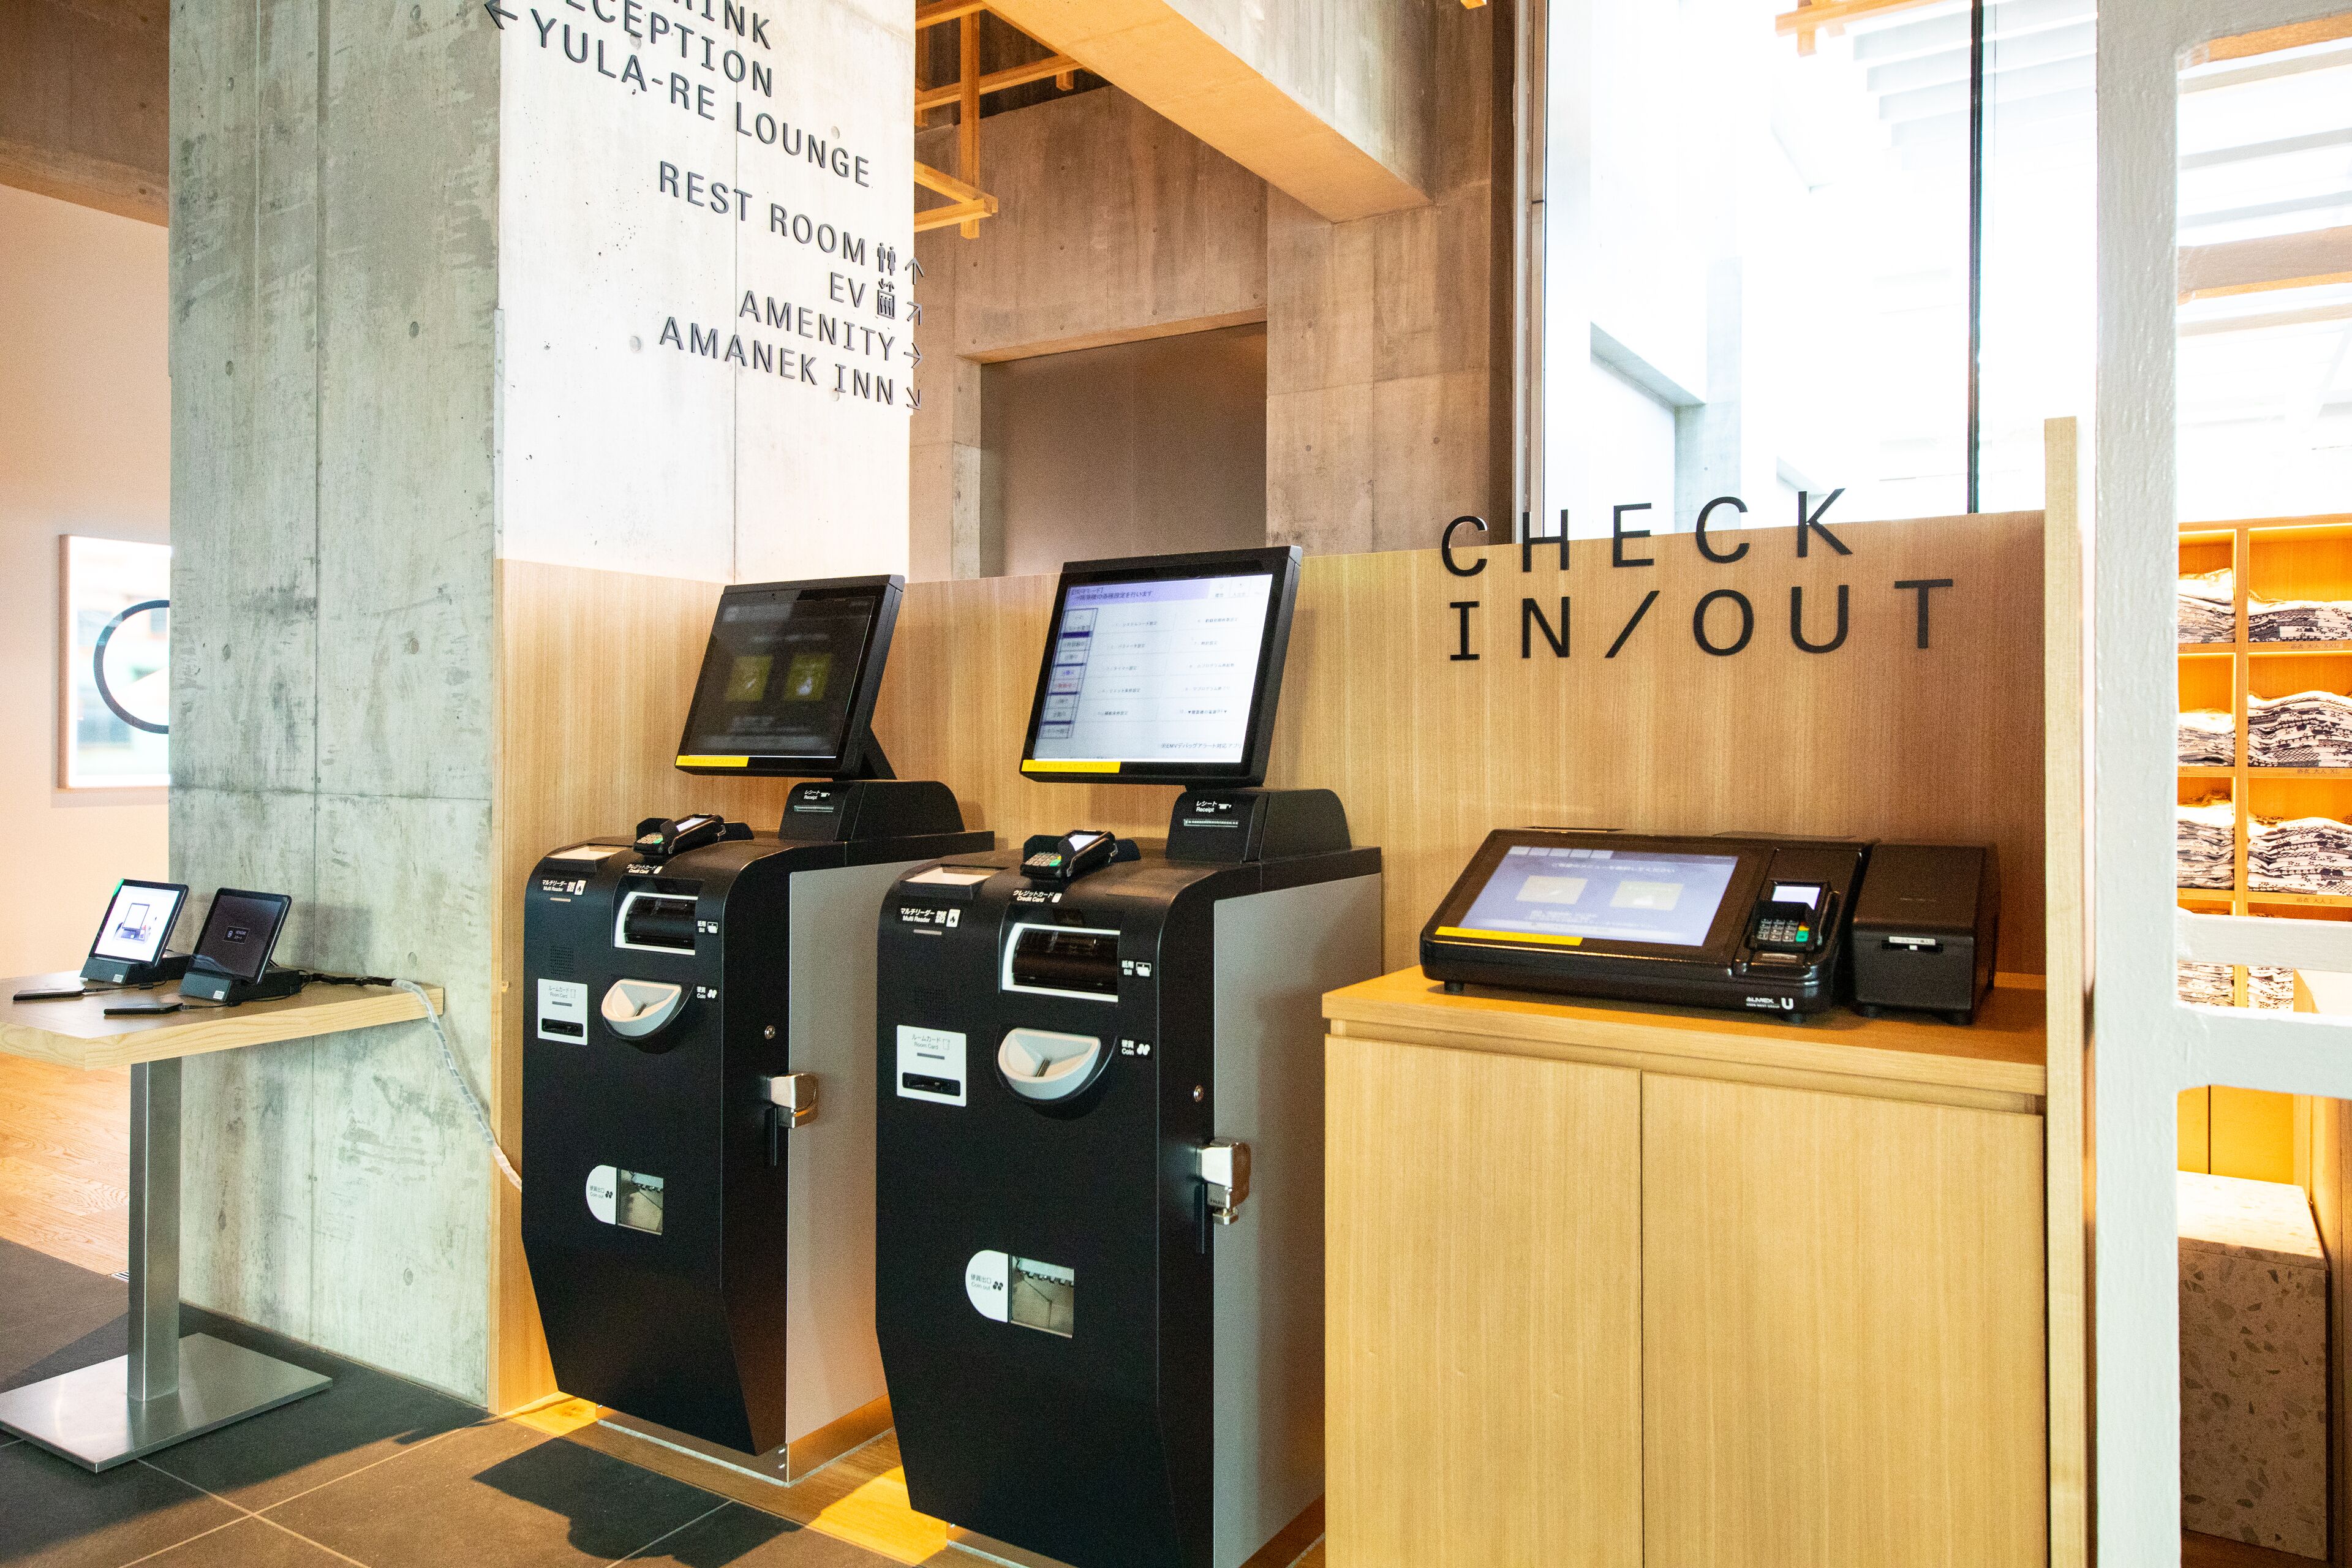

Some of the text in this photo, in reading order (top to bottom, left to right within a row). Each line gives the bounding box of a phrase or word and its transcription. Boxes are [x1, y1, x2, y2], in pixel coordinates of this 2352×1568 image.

[686, 0, 771, 50] INK
[531, 9, 869, 187] YULA-RE LOUNGE
[660, 160, 865, 266] REST ROOM
[739, 290, 895, 361] AMENITY
[831, 272, 866, 308] EV
[660, 317, 894, 405] AMANEK INN
[1441, 488, 1853, 578] CHECK
[1450, 579, 1954, 660] IN/OUT
[900, 908, 935, 916] マルチリーダー
[1781, 997, 1794, 1010] U
